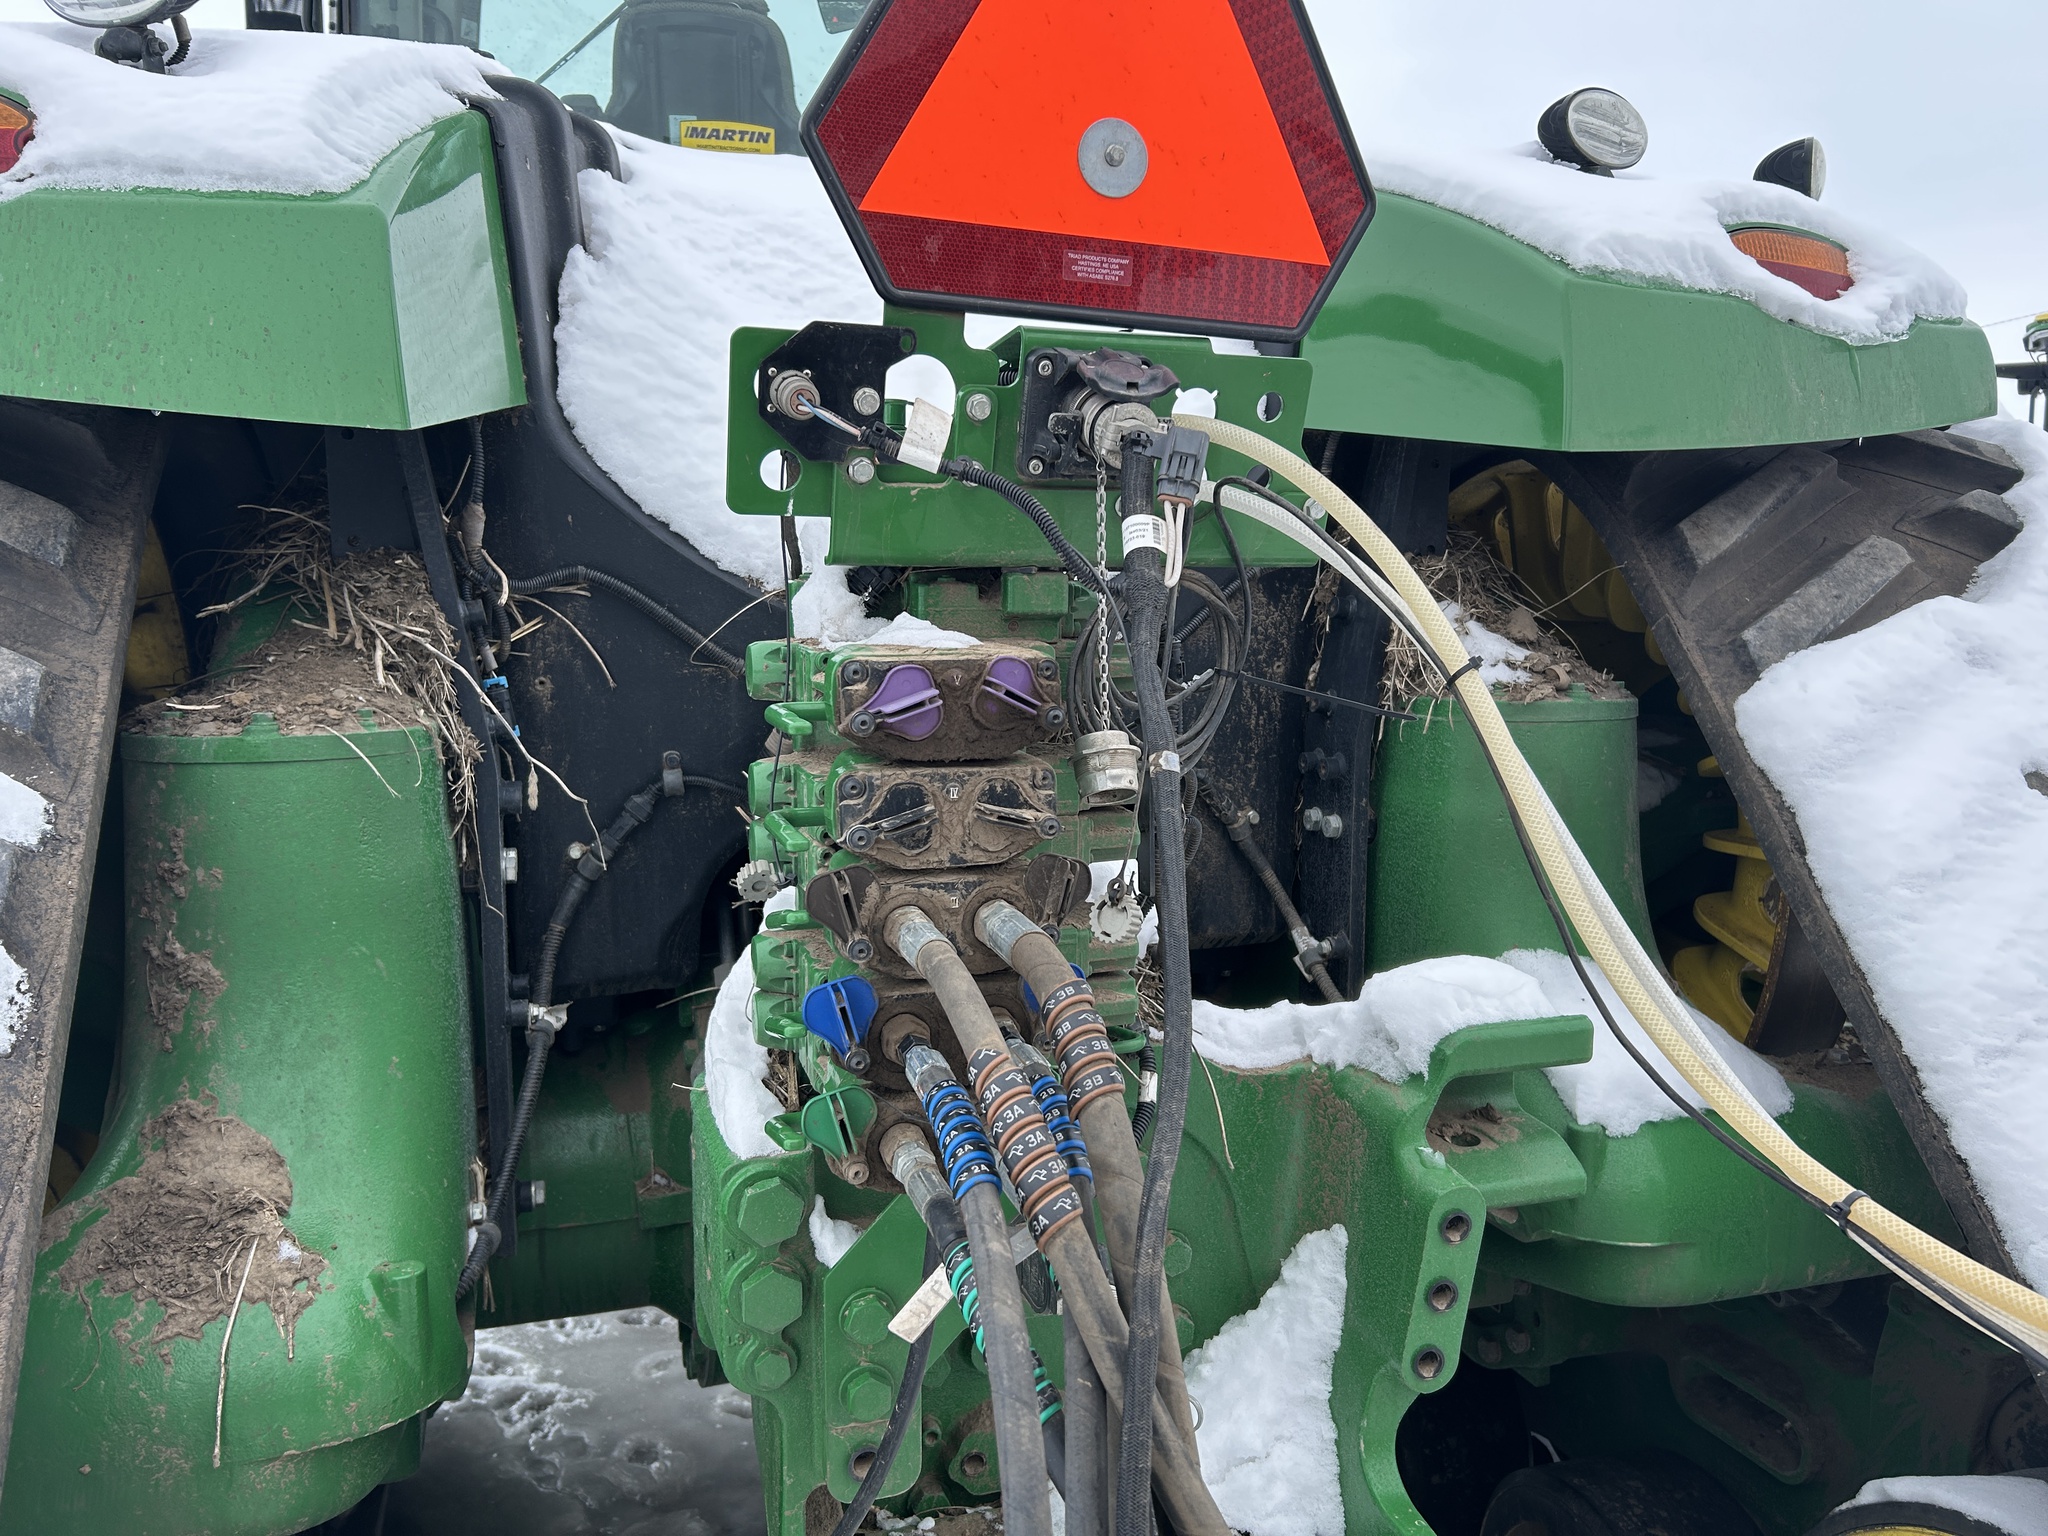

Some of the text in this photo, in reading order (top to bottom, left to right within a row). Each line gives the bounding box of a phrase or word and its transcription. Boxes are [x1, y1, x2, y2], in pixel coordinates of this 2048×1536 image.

[687, 126, 771, 144] MARTIN
[1082, 254, 1107, 262] PRODUCTS
[1107, 257, 1130, 265] COMPANY
[1095, 268, 1125, 277] COMPLIANCE
[1056, 985, 1075, 1000] 3B
[1055, 1020, 1072, 1040] 3B
[1091, 1040, 1110, 1050] 3B
[1083, 1074, 1104, 1091] 3B
[983, 1083, 1001, 1104] 3A
[1040, 1087, 1056, 1099] 2B
[1003, 1104, 1025, 1123] 3A
[1045, 1108, 1061, 1121] 2B
[944, 1130, 959, 1145] 2A
[1025, 1130, 1047, 1147] 3A
[955, 1144, 974, 1157] 2A
[971, 1164, 990, 1173] 2A
[1048, 1158, 1067, 1174] 3A
[1032, 1214, 1050, 1235] 3A
